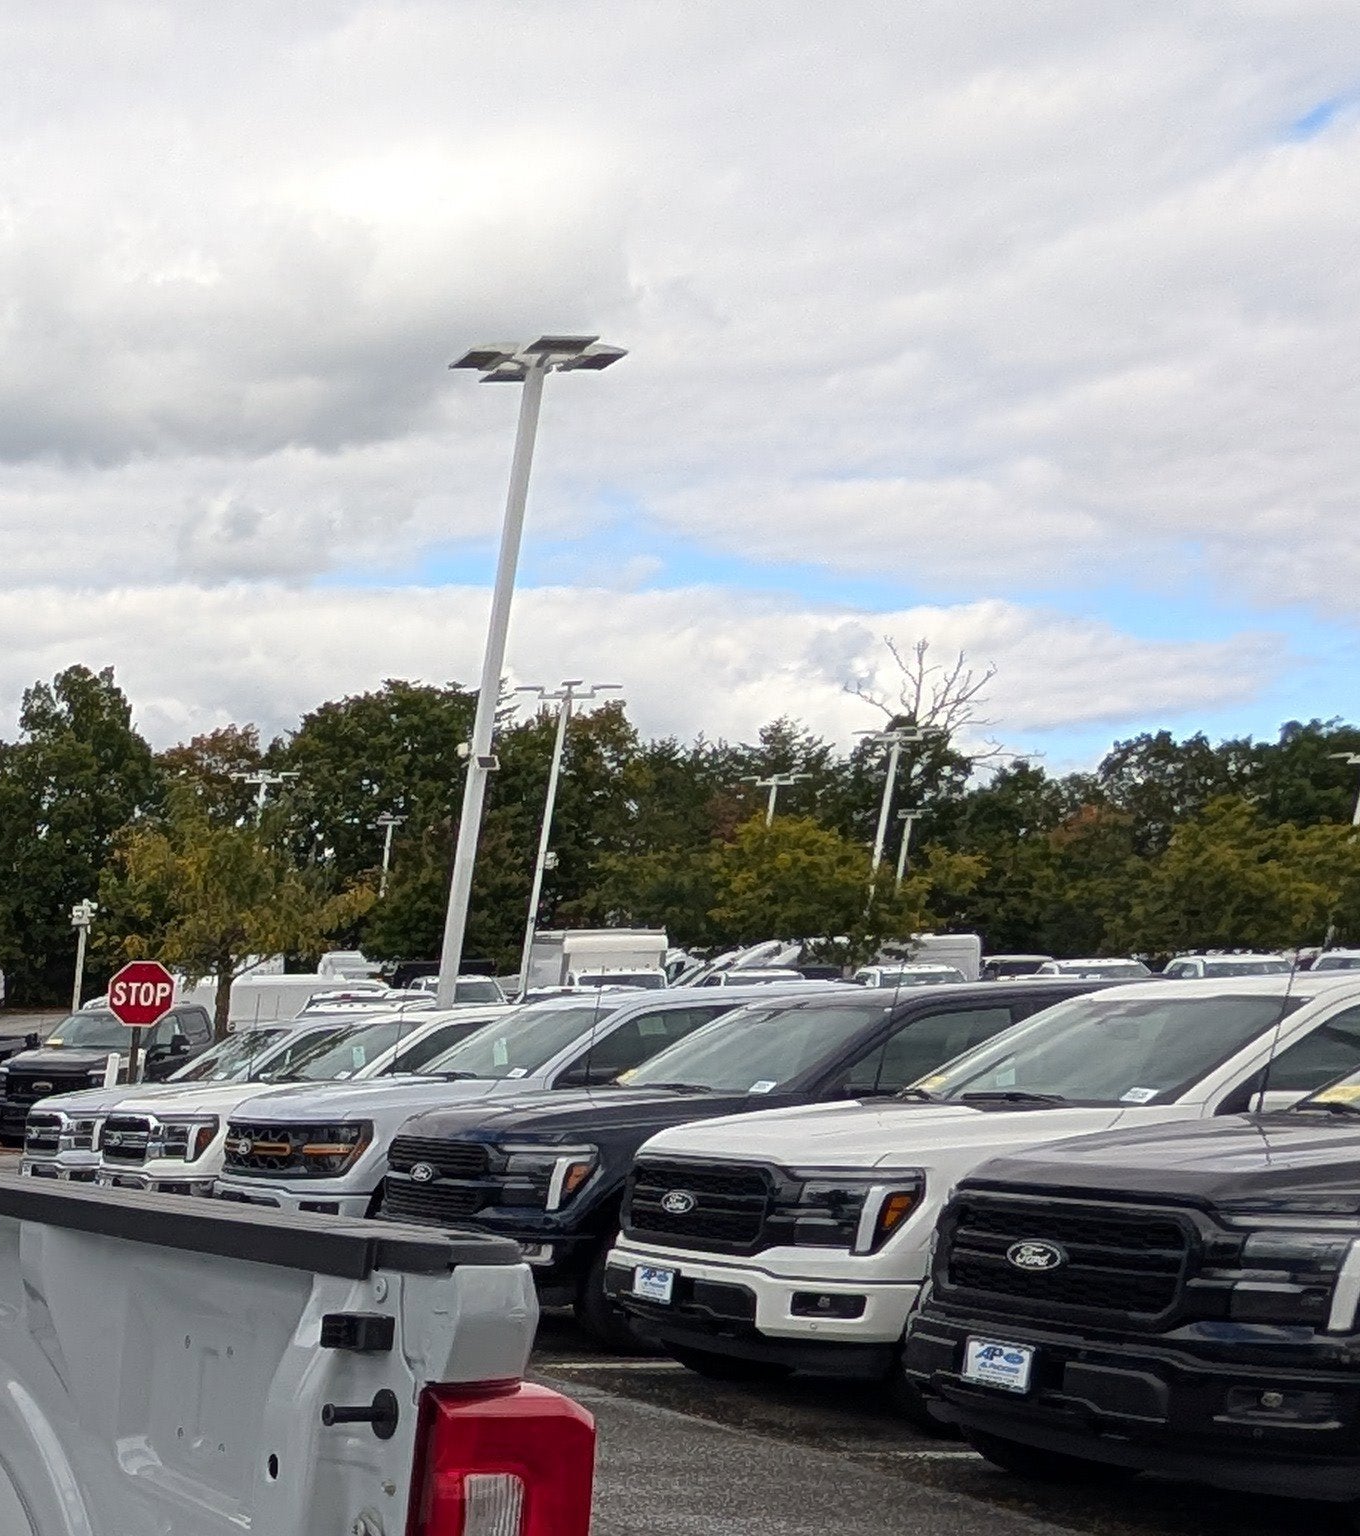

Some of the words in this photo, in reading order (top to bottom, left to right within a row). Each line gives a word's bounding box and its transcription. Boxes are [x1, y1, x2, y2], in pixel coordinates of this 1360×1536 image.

[112, 981, 171, 1007] STOP
[1016, 1246, 1051, 1266] Ford
[975, 1346, 1004, 1361] AP
